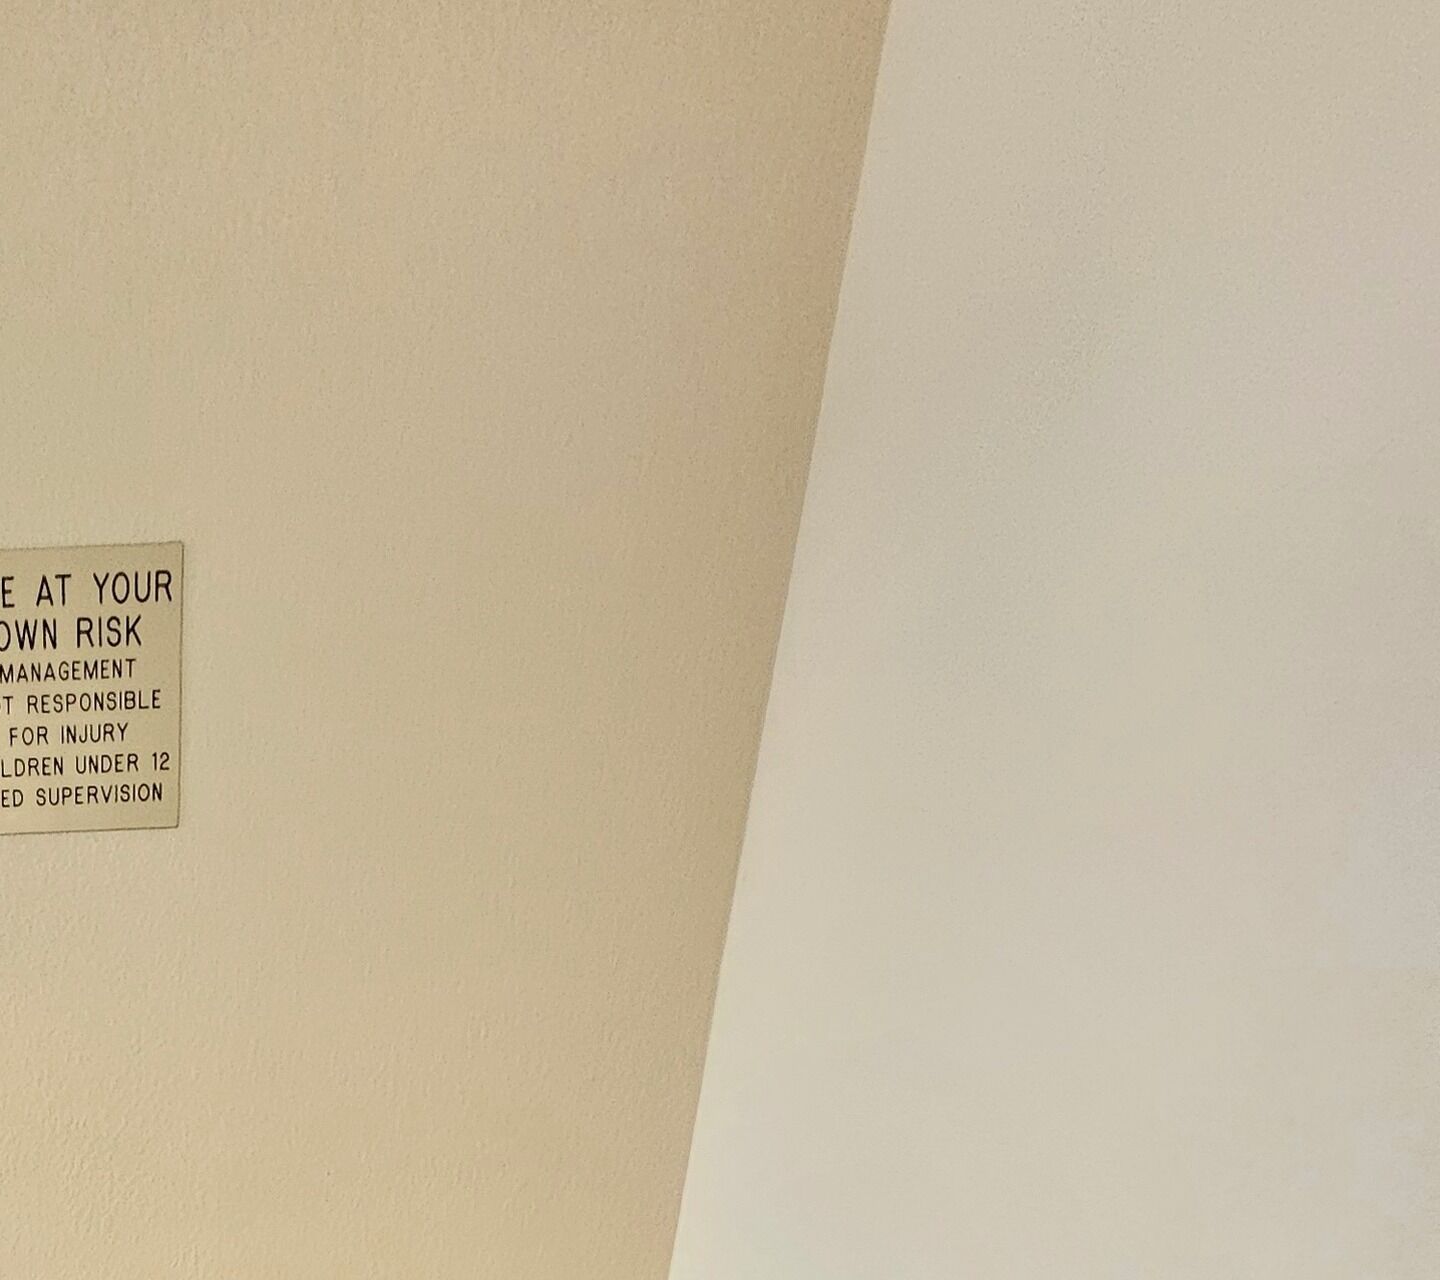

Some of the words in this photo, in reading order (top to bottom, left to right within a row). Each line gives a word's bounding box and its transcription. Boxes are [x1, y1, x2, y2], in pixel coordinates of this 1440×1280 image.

[36, 574, 72, 607] AT
[93, 570, 172, 604] YOUR
[76, 615, 142, 648] RISK
[0, 658, 136, 683] MANAGEMENT
[27, 689, 161, 714] RESPONSIBLE
[9, 727, 48, 746] FOR
[61, 723, 128, 744] INJURY
[76, 753, 139, 774] UNDER
[152, 752, 170, 771] 12
[36, 783, 162, 806] SUPERVISION
